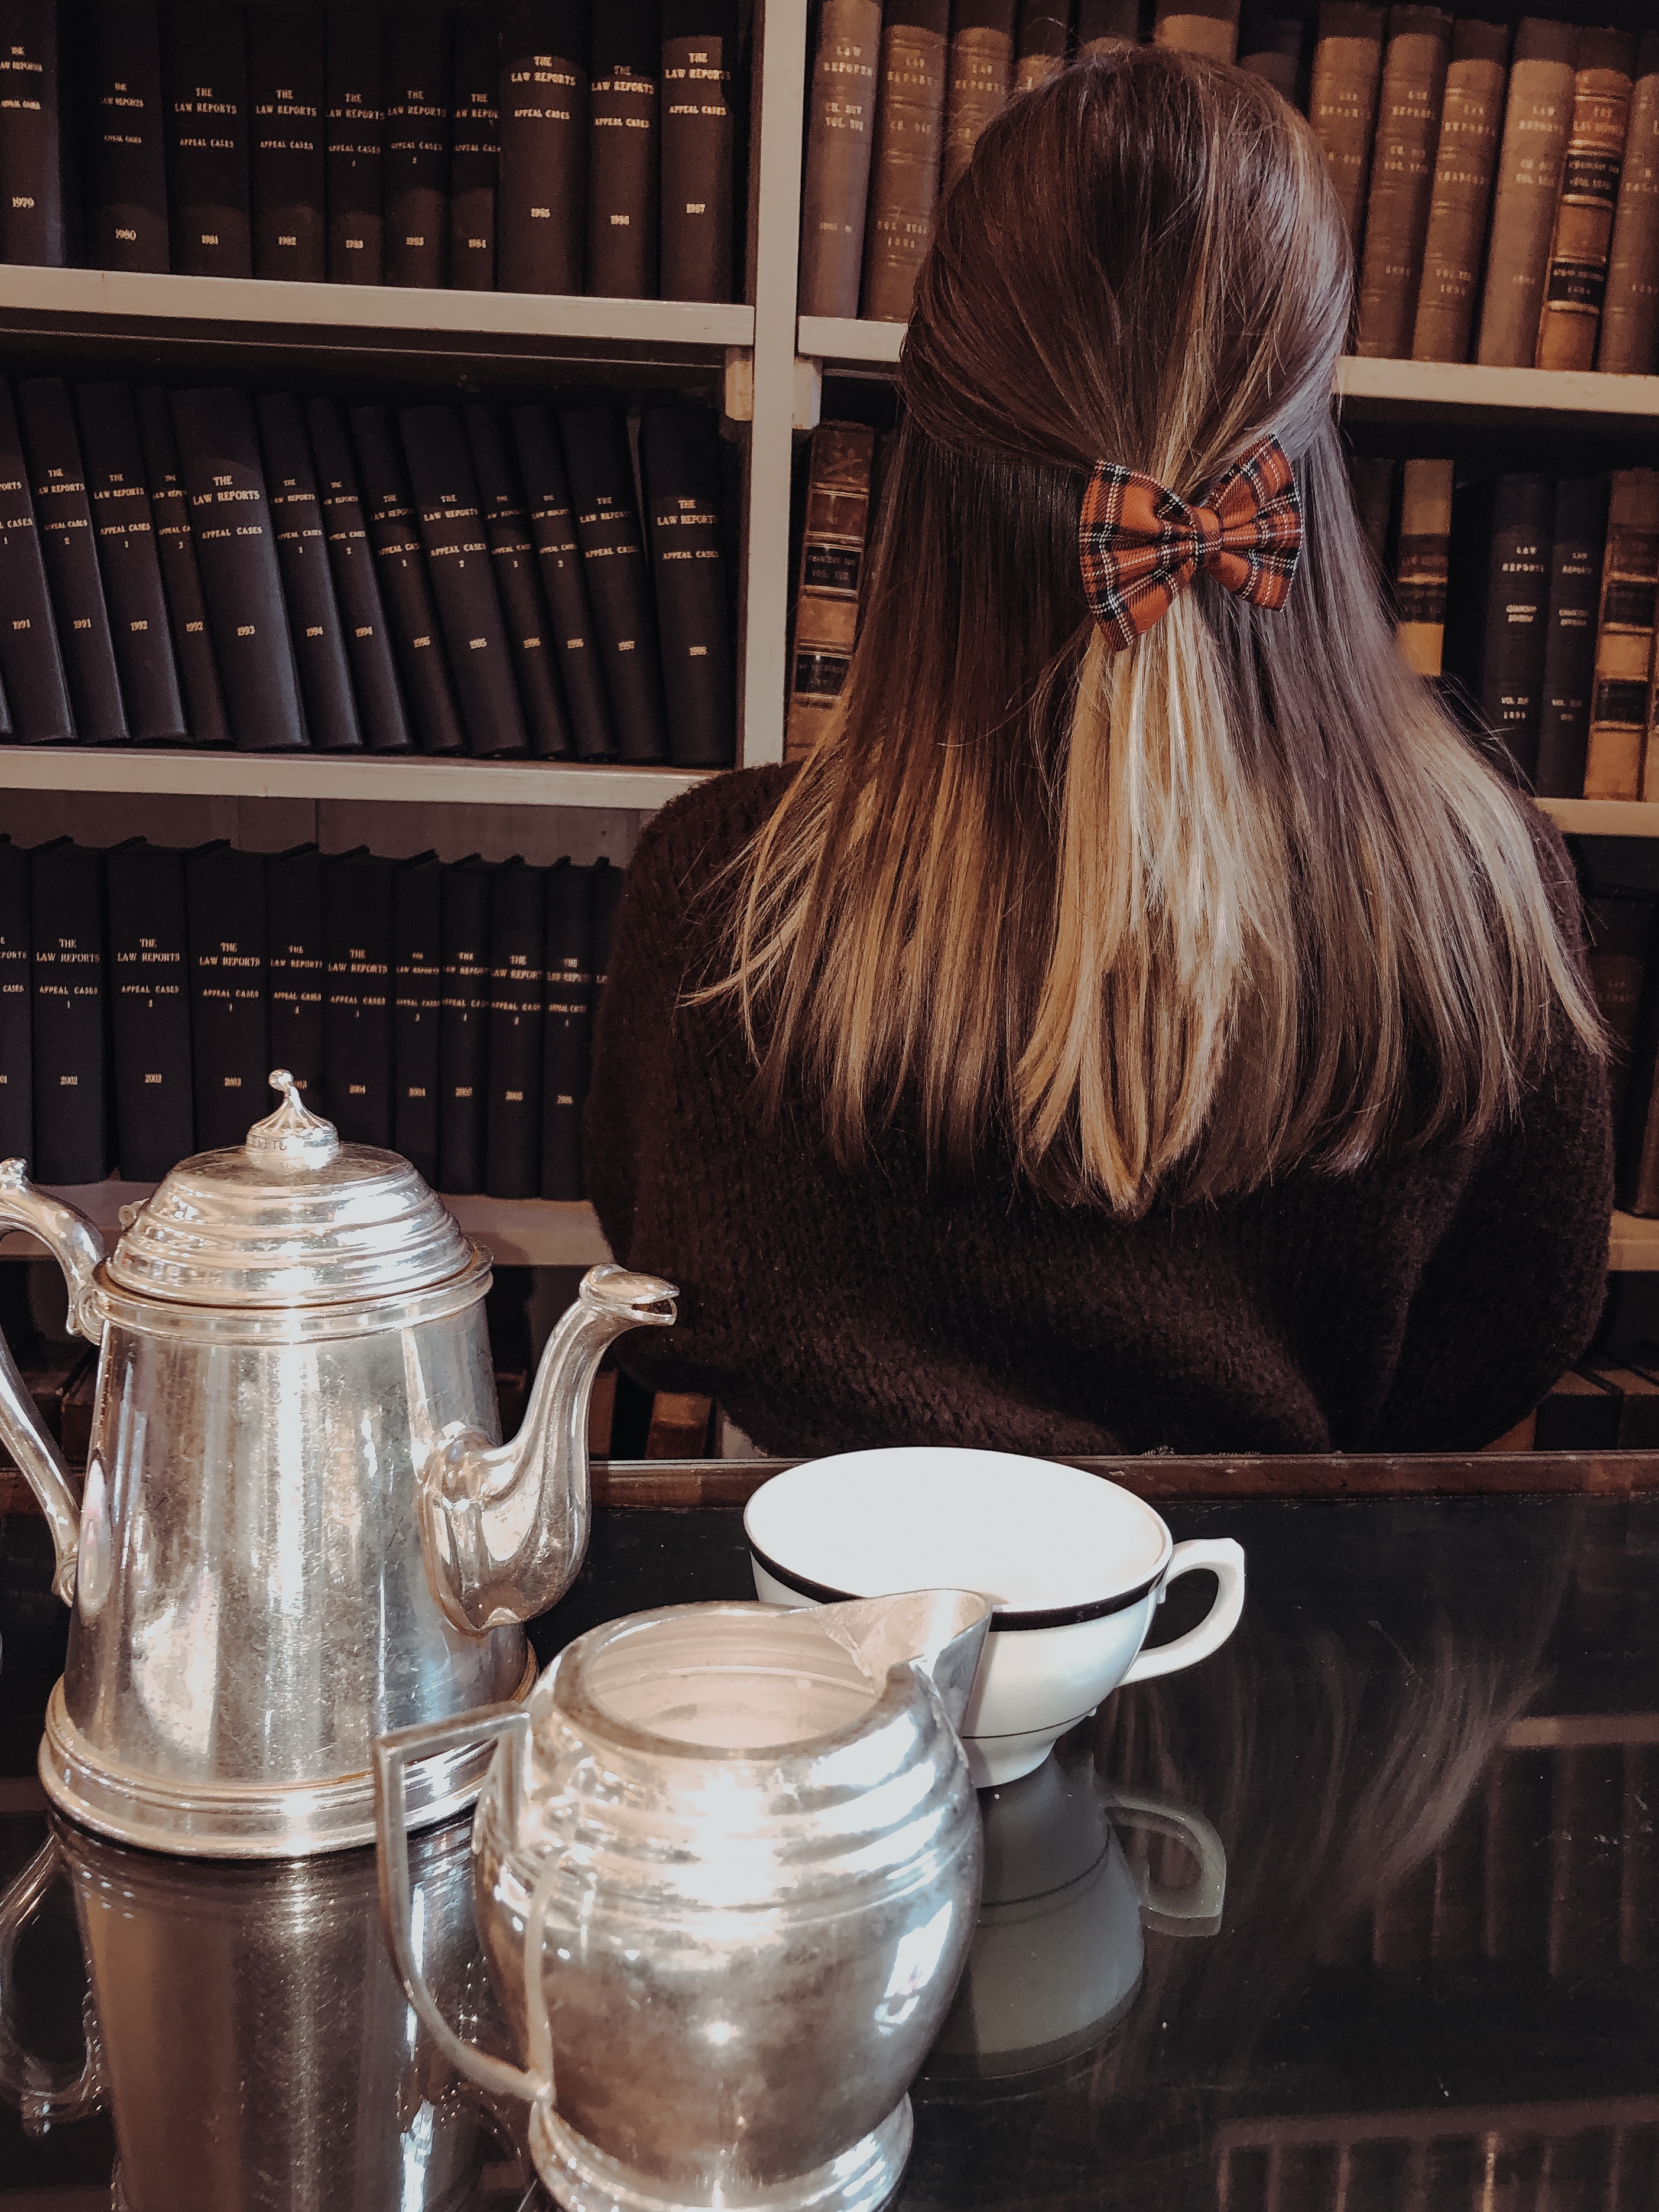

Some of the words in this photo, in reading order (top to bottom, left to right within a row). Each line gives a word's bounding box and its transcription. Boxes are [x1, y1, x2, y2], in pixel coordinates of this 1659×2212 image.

[836, 44, 862, 57] LAW
[533, 56, 553, 67] THE
[688, 52, 708, 63] THE
[613, 65, 632, 77] THE
[665, 68, 686, 79] LAW
[687, 68, 732, 80] REPORTS
[511, 72, 531, 83] LAW
[534, 72, 576, 86] REPORTS
[195, 87, 213, 97] THE
[591, 81, 611, 92] LAW
[613, 80, 654, 95] REPORTS
[275, 89, 294, 100] THE
[345, 93, 363, 103] THE
[405, 90, 425, 100] THE
[470, 93, 488, 103] THE
[174, 103, 193, 112] LAW
[196, 102, 237, 115] REPORTS
[256, 104, 273, 115] LAW
[277, 105, 317, 117] REPORTS
[388, 106, 404, 116] LAW
[407, 105, 447, 117] REPORTS
[669, 105, 699, 115] APPEAL
[701, 105, 726, 116] CASES
[345, 109, 385, 120] REPORTS
[514, 109, 543, 118] APPEAL
[545, 109, 570, 120] CASES
[594, 117, 624, 126] APPEAL
[625, 118, 650, 129] CASES
[180, 138, 207, 147] APPEAL
[210, 139, 234, 148] CASES
[260, 140, 287, 148] APPEAL
[290, 140, 314, 150] CASES
[418, 141, 443, 151] CASES
[455, 144, 479, 152] APPEAL
[328, 144, 354, 152] APPEAL
[357, 145, 381, 154] CASES
[47, 468, 64, 478] THE
[108, 473, 124, 482] THE
[212, 475, 233, 486] THE
[283, 478, 296, 486] THE
[51, 482, 85, 493] REPORTS
[93, 490, 110, 499] LAW
[112, 487, 144, 497] REPORTS
[193, 493, 212, 506] LAW
[216, 490, 260, 502] REPORTS
[287, 493, 316, 502] REPORTS
[335, 496, 358, 504] REPORTS
[383, 494, 398, 503] THE
[440, 494, 457, 503] THE
[596, 496, 612, 505] THE
[677, 499, 696, 509] THE
[424, 512, 442, 521] LAW
[444, 508, 478, 518] REPORTS
[579, 514, 597, 524] LAW
[7, 517, 34, 528] CASES
[67, 519, 88, 528] CASES
[657, 515, 678, 526] LAW
[680, 515, 714, 525] REPORTS
[100, 524, 126, 535] APPEAL
[128, 522, 151, 532] CASES
[202, 528, 232, 539] APPEAL
[236, 526, 263, 535] CASES
[302, 529, 323, 537] CASES
[431, 545, 460, 557] APPEAL
[463, 543, 486, 552] CASES
[585, 547, 614, 558] APPEAL
[663, 551, 693, 560] APPEAL
[695, 550, 719, 558] CASES
[59, 938, 77, 949] THE
[139, 938, 157, 948] THE
[220, 942, 238, 953] THE
[288, 945, 304, 954] THE
[349, 949, 367, 959] THE
[36, 951, 56, 962] LAW
[60, 953, 100, 963] REPORTS
[117, 952, 137, 962] LAW
[142, 952, 180, 962] REPORTS
[458, 952, 473, 960] THE
[509, 954, 527, 966] THE
[199, 956, 218, 966] LAW
[222, 956, 260, 967] REPORTS
[268, 959, 287, 967] LAW
[290, 959, 323, 969] REPORTS
[328, 962, 347, 972] LAW
[350, 963, 388, 974] REPORTS
[412, 966, 440, 975] REPORTS
[2, 984, 24, 993] CASES
[39, 985, 69, 995] APPEAL
[73, 986, 98, 995] CASES
[121, 985, 150, 994] APPEAL
[155, 985, 179, 994] CASES
[203, 989, 230, 998] APPEAL
[235, 989, 259, 998] CASES
[274, 992, 298, 1001] APPEAL
[300, 992, 322, 1002] CASES
[330, 995, 358, 1004] APPEAL
[362, 996, 386, 1005] CASES
